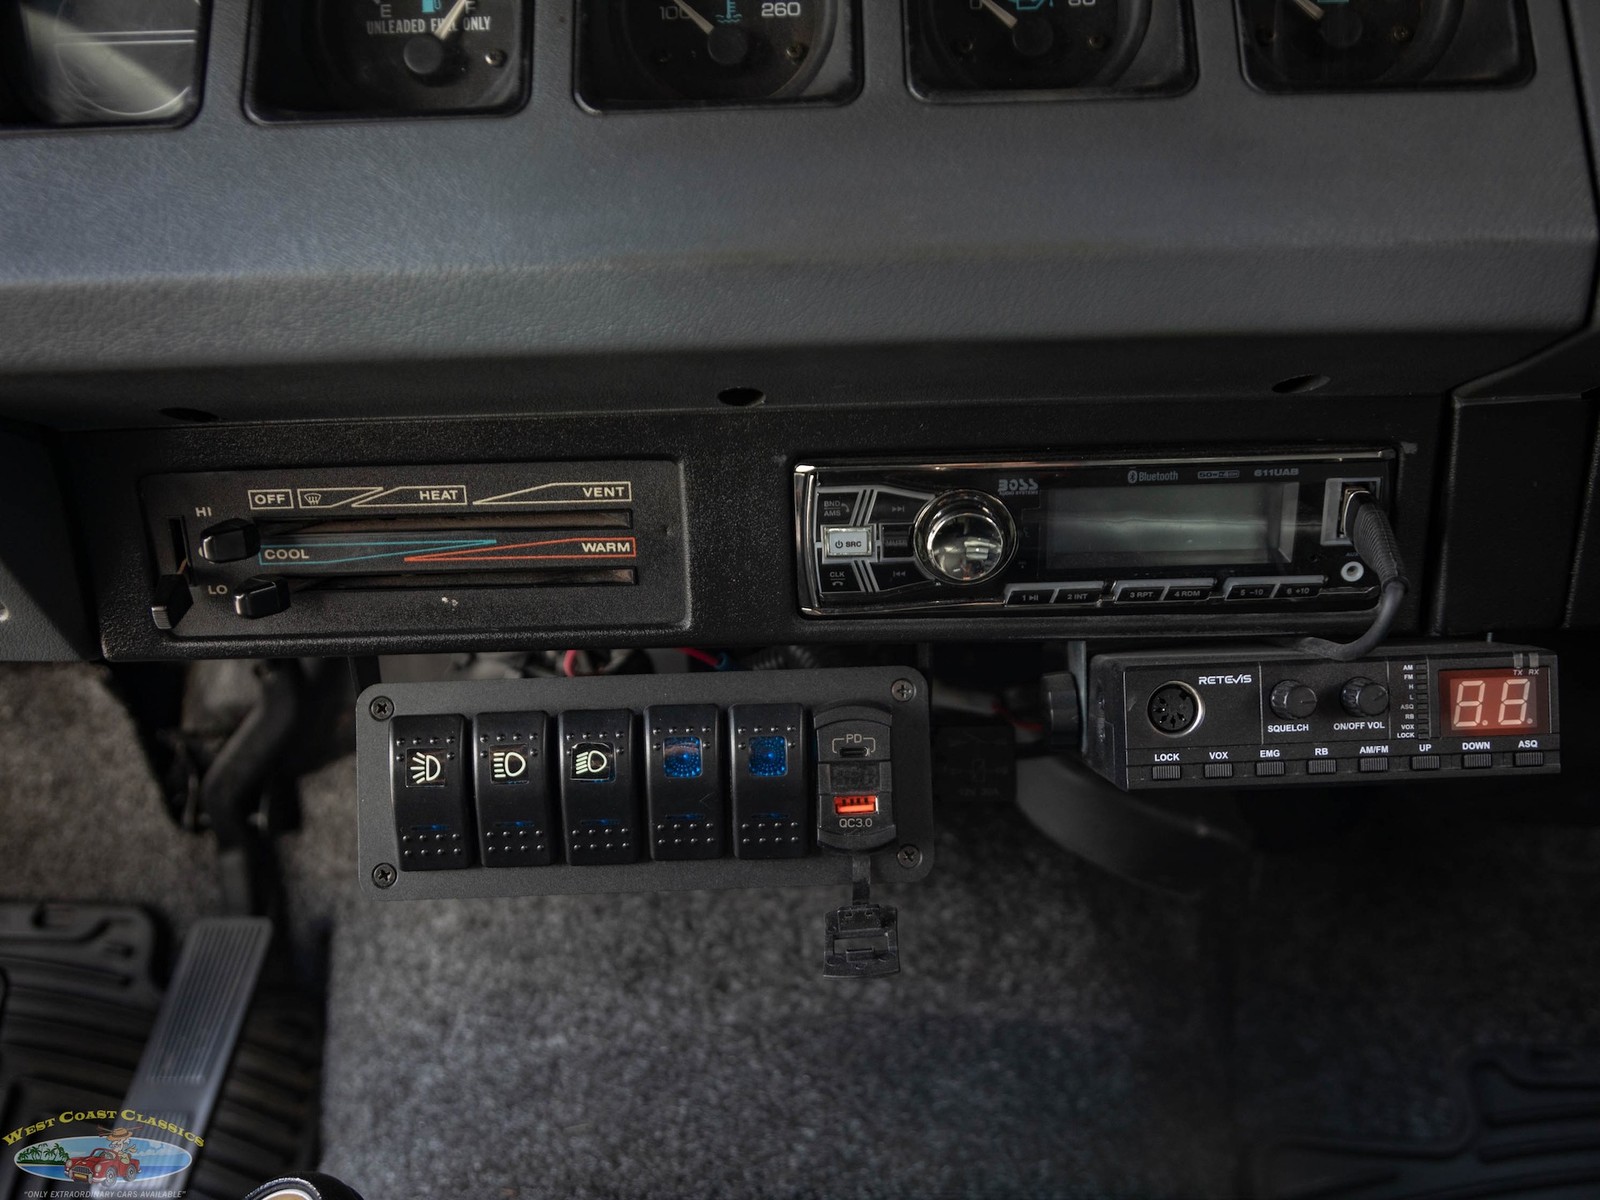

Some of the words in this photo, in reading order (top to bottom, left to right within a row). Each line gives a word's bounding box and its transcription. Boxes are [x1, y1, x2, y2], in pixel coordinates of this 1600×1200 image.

[380, 4, 392, 18] E
[465, 0, 476, 14] F
[761, 2, 801, 17] 260
[366, 18, 426, 35] UNLEADED
[463, 16, 492, 32] ONLY
[1138, 471, 1179, 482] Bluetooth
[997, 478, 1039, 492] BOSS
[419, 490, 458, 501] HEAT
[583, 486, 625, 498] VENT
[254, 494, 286, 505] OFF
[823, 500, 841, 508] BND
[195, 507, 212, 517] HI
[823, 509, 841, 517] AMS
[582, 542, 631, 553] WARM
[264, 549, 310, 560] COOL
[207, 584, 228, 595] LO
[1181, 590, 1201, 598] RDM
[1136, 591, 1153, 599] RPT
[1528, 668, 1540, 676] RX
[1198, 674, 1252, 685] RETEVIS
[1267, 723, 1310, 733] SQUELCH
[1333, 721, 1366, 731] ON/OFF
[1366, 721, 1386, 730] VOL
[846, 733, 863, 744] PD
[1517, 739, 1538, 748] ASQ
[1359, 745, 1389, 754] AM/FM
[1418, 743, 1433, 752] UP
[1462, 741, 1491, 750] DOWN
[1209, 751, 1229, 760] VOX
[1259, 749, 1281, 758] EMG
[1314, 747, 1329, 756] RB
[1154, 753, 1180, 762] LOCK
[839, 818, 873, 829] QC3.0
